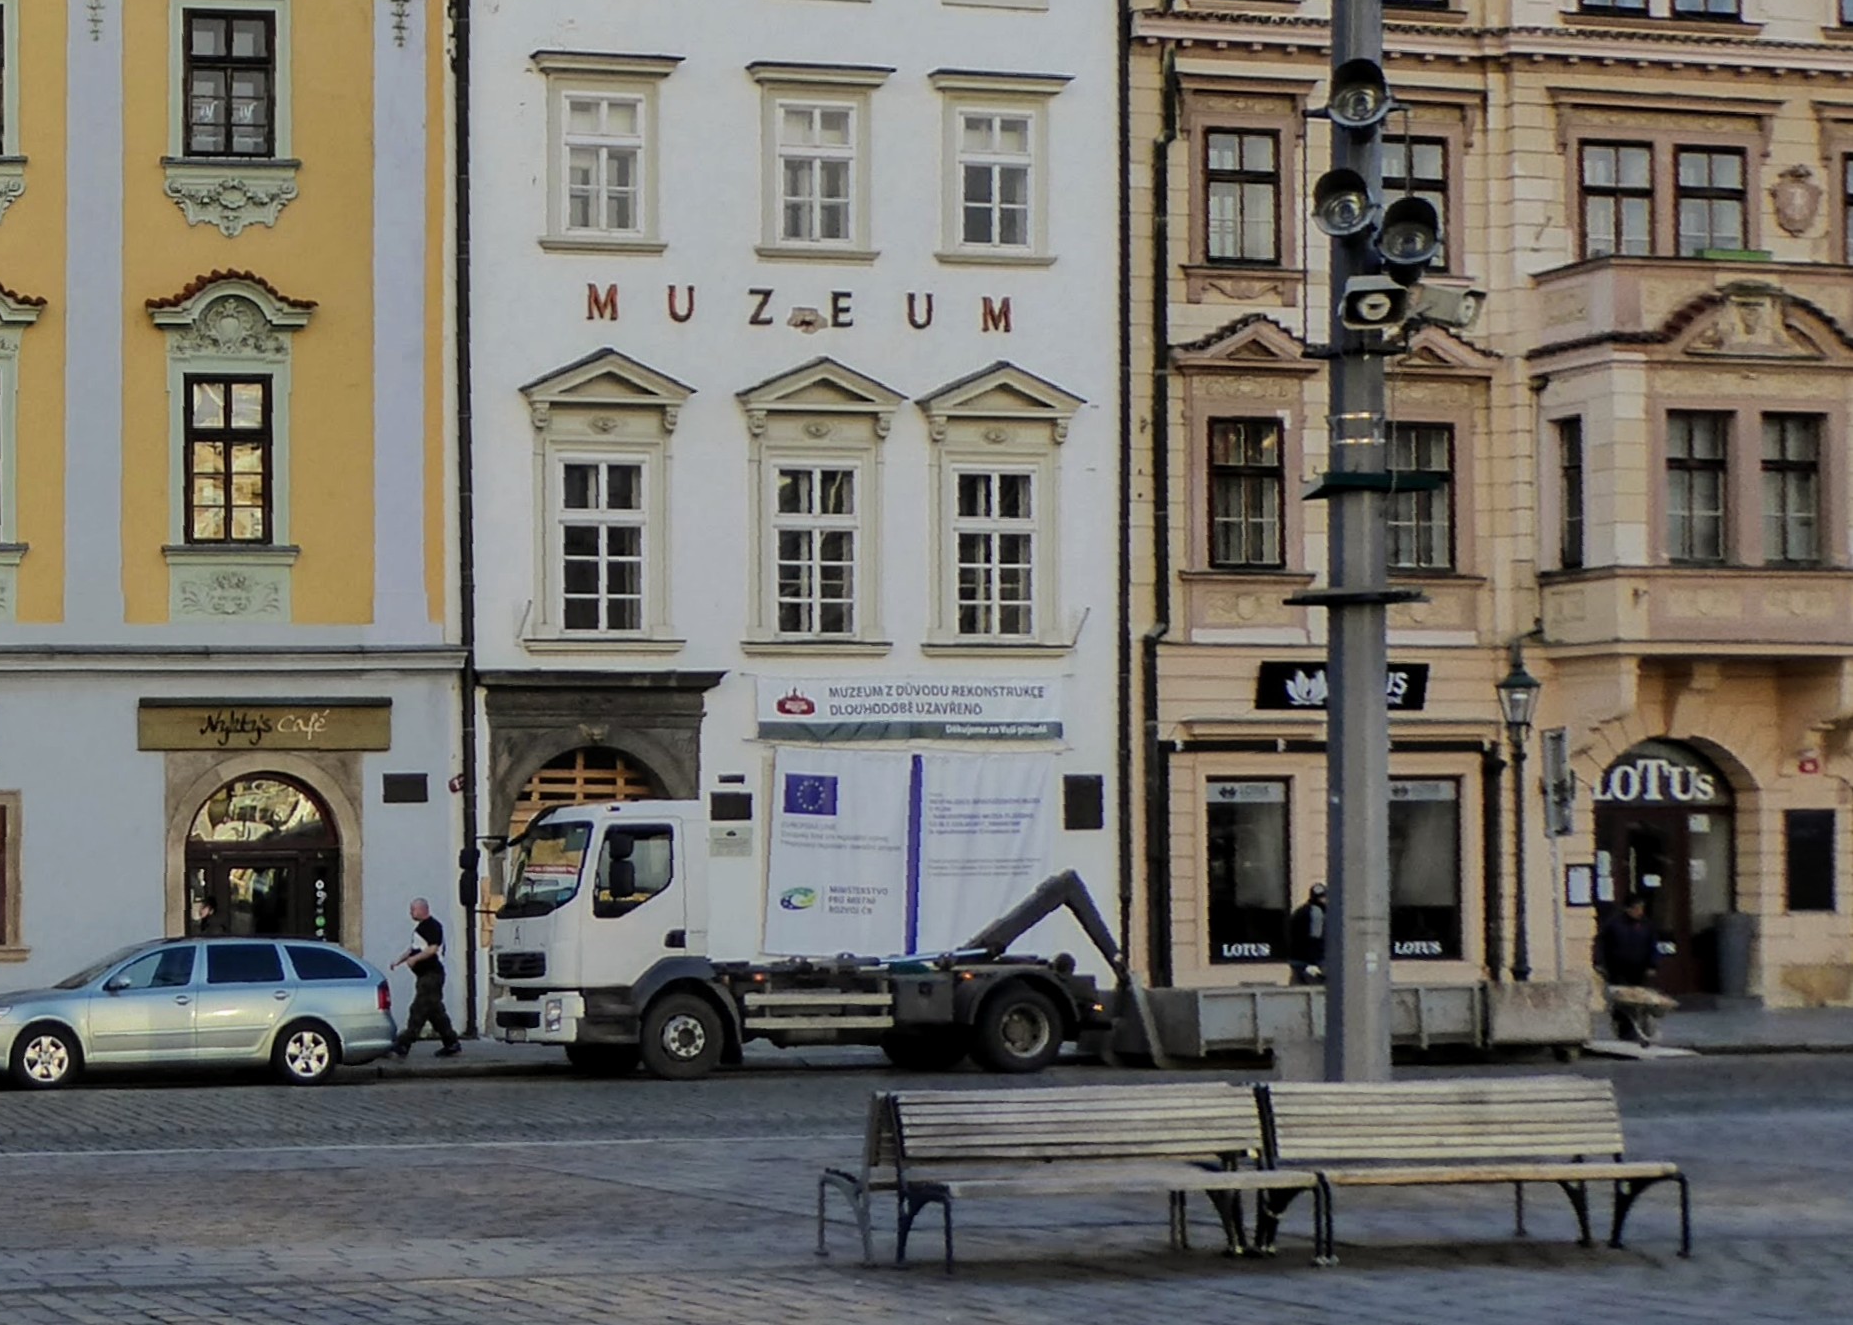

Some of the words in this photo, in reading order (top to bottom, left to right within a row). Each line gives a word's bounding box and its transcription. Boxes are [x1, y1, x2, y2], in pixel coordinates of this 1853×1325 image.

[586, 283, 1013, 333] MUZEUM
[829, 686, 883, 698] MUZEUM
[886, 685, 893, 696] Z
[896, 682, 949, 696] DŮVODU
[951, 685, 1044, 699] REKONSTRUKCE
[829, 702, 913, 715] DLOUHODOBĚ
[915, 701, 982, 715] UZAVŘENO
[277, 709, 330, 740] Café
[1592, 759, 1715, 801] LOTUS
[1223, 943, 1271, 957] LOTUS
[1395, 941, 1442, 955] LOTUS
